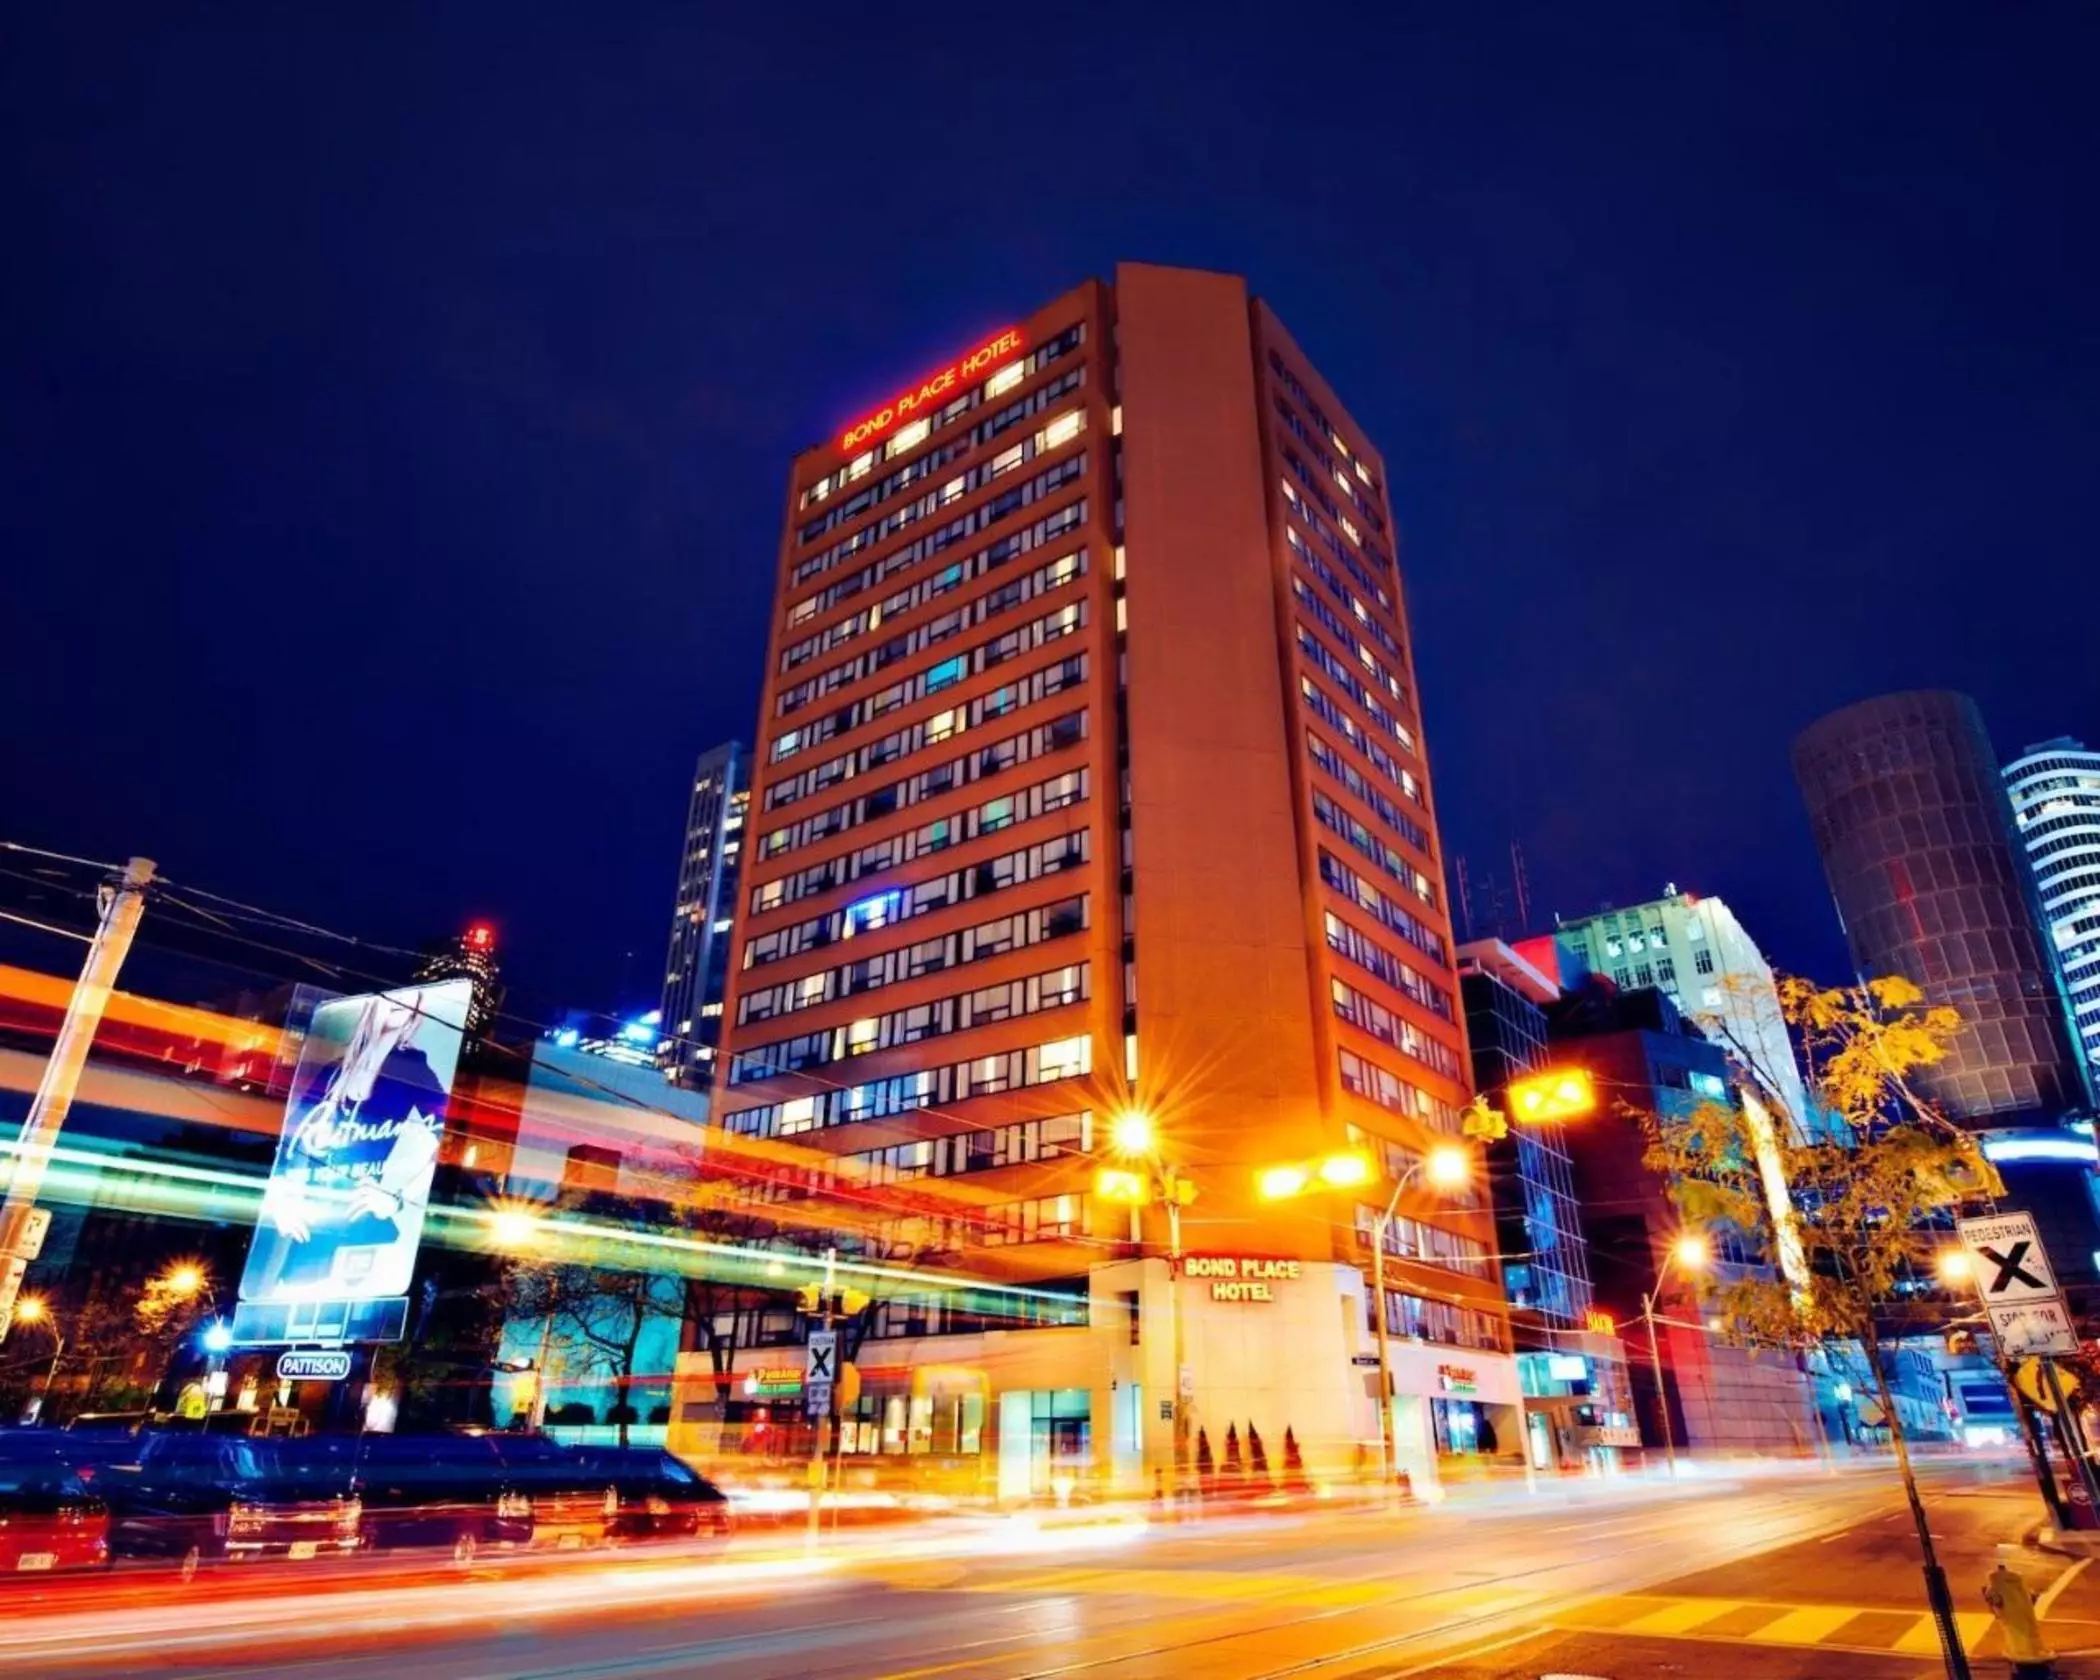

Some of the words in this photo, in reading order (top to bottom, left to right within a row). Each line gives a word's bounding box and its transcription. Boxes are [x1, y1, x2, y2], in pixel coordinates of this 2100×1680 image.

[843, 409, 893, 450] BOND
[898, 368, 956, 416] PLACE
[962, 330, 1021, 378] HOTEL
[1963, 1223, 2032, 1243] PEDESTRIAN
[1185, 1258, 1237, 1277] BOND
[1241, 1259, 1301, 1279] PLACE
[1212, 1282, 1274, 1302] HOTEL
[282, 1358, 346, 1374] PATTISON
